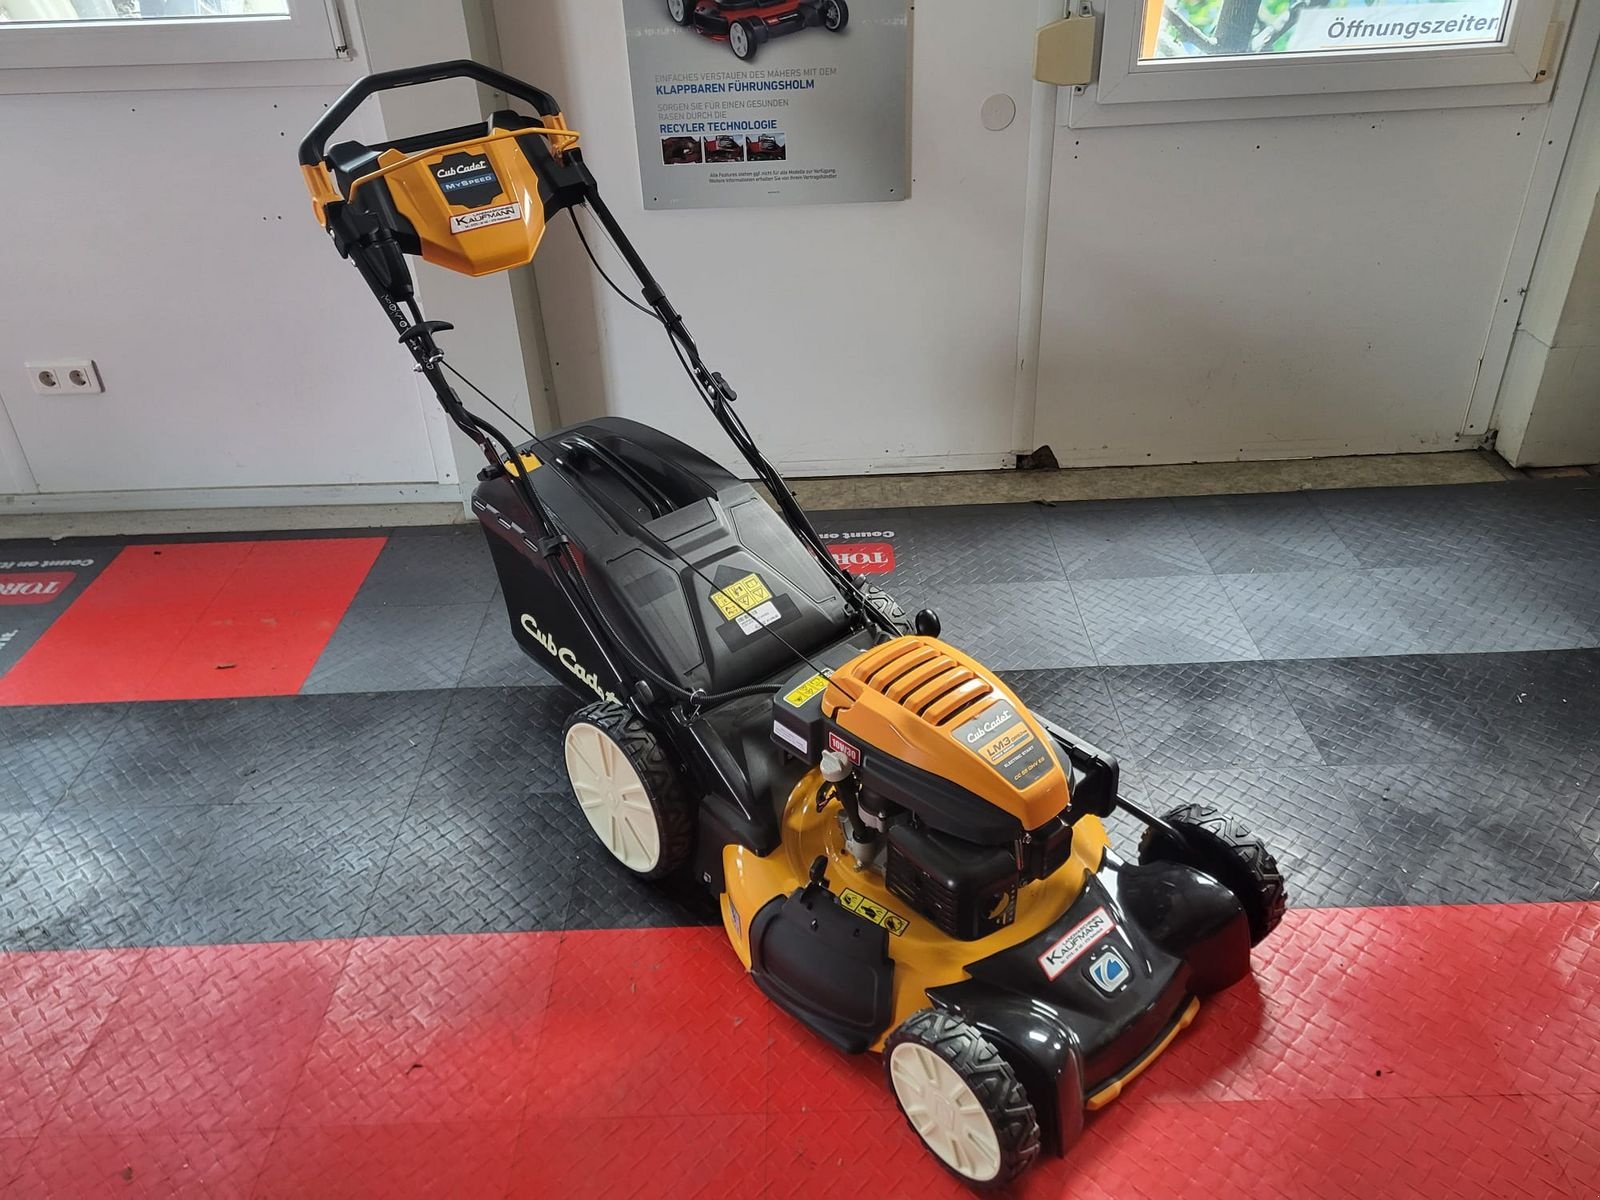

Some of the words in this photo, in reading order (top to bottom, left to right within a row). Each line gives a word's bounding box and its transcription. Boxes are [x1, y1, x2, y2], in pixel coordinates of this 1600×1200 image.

[1327, 14, 1500, 39] Öffnungszeiten
[655, 73, 699, 82] EINFACHES
[700, 71, 748, 80] VERSTAUEN
[749, 70, 765, 78] DES
[767, 68, 802, 78] MÄHERS
[803, 67, 817, 76] MIT
[819, 67, 837, 76] DEM
[656, 82, 726, 95] KLAPPBAREN
[728, 79, 815, 92] FÜHRUNGSHOLM
[657, 102, 689, 112] SORGEN
[691, 102, 703, 110] SIE
[704, 100, 721, 110] FÜR
[722, 100, 745, 109] EINEN
[746, 98, 789, 108] GESUNDEN
[658, 111, 685, 121] RASEN
[686, 111, 713, 120] DURCH
[714, 110, 727, 119] DIE
[659, 122, 705, 134] RECYLER
[707, 120, 778, 132] TECHNOLOGIE
[437, 168, 457, 178] Cub
[456, 160, 487, 174] Cadet
[455, 208, 515, 226] KAUFMANN
[843, 530, 895, 539] Count
[41, 559, 95, 568] Count
[832, 551, 889, 565] TOR
[0, 581, 60, 596] TOR
[520, 613, 558, 657] Cub
[967, 730, 986, 743] Cub
[983, 710, 1012, 733] Cadet
[987, 736, 1011, 757] LM3
[1020, 745, 1034, 757] START
[1046, 919, 1104, 965] KAUFMANN
